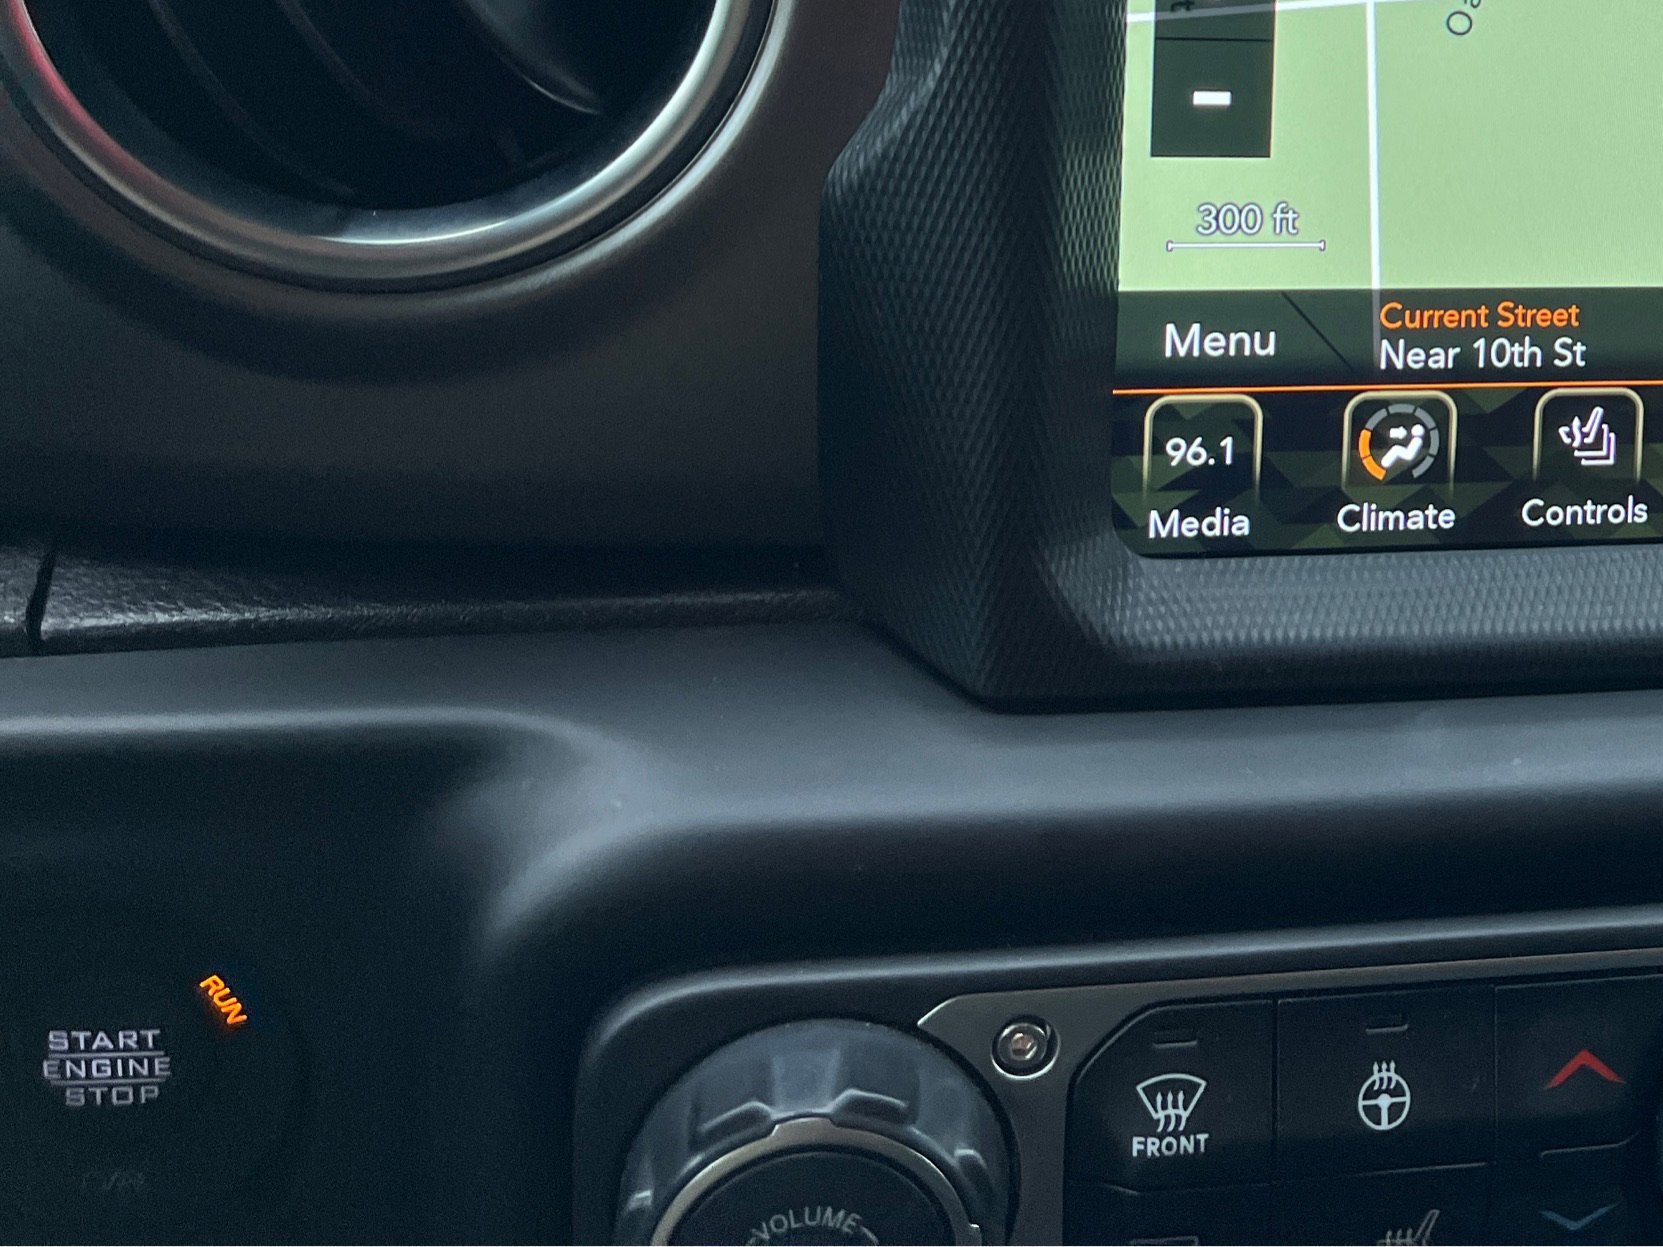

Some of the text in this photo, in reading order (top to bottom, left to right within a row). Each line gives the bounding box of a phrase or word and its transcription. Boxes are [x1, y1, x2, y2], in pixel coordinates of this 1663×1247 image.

[1196, 200, 1301, 236] 300 ft
[1379, 300, 1581, 330] Current Street
[1163, 322, 1277, 359] Menu
[1379, 336, 1587, 370] Near 10th St
[1164, 436, 1235, 468] 96.1
[1147, 506, 1252, 540] Media
[1336, 501, 1457, 533] Climate
[1520, 495, 1649, 527] Controls
[199, 974, 248, 1026] RUN
[48, 1028, 162, 1052] START
[42, 1056, 171, 1080] ENGINE
[65, 1084, 160, 1107] STOP
[1131, 1132, 1210, 1158] FRONT
[750, 1204, 863, 1242] VOLUME
